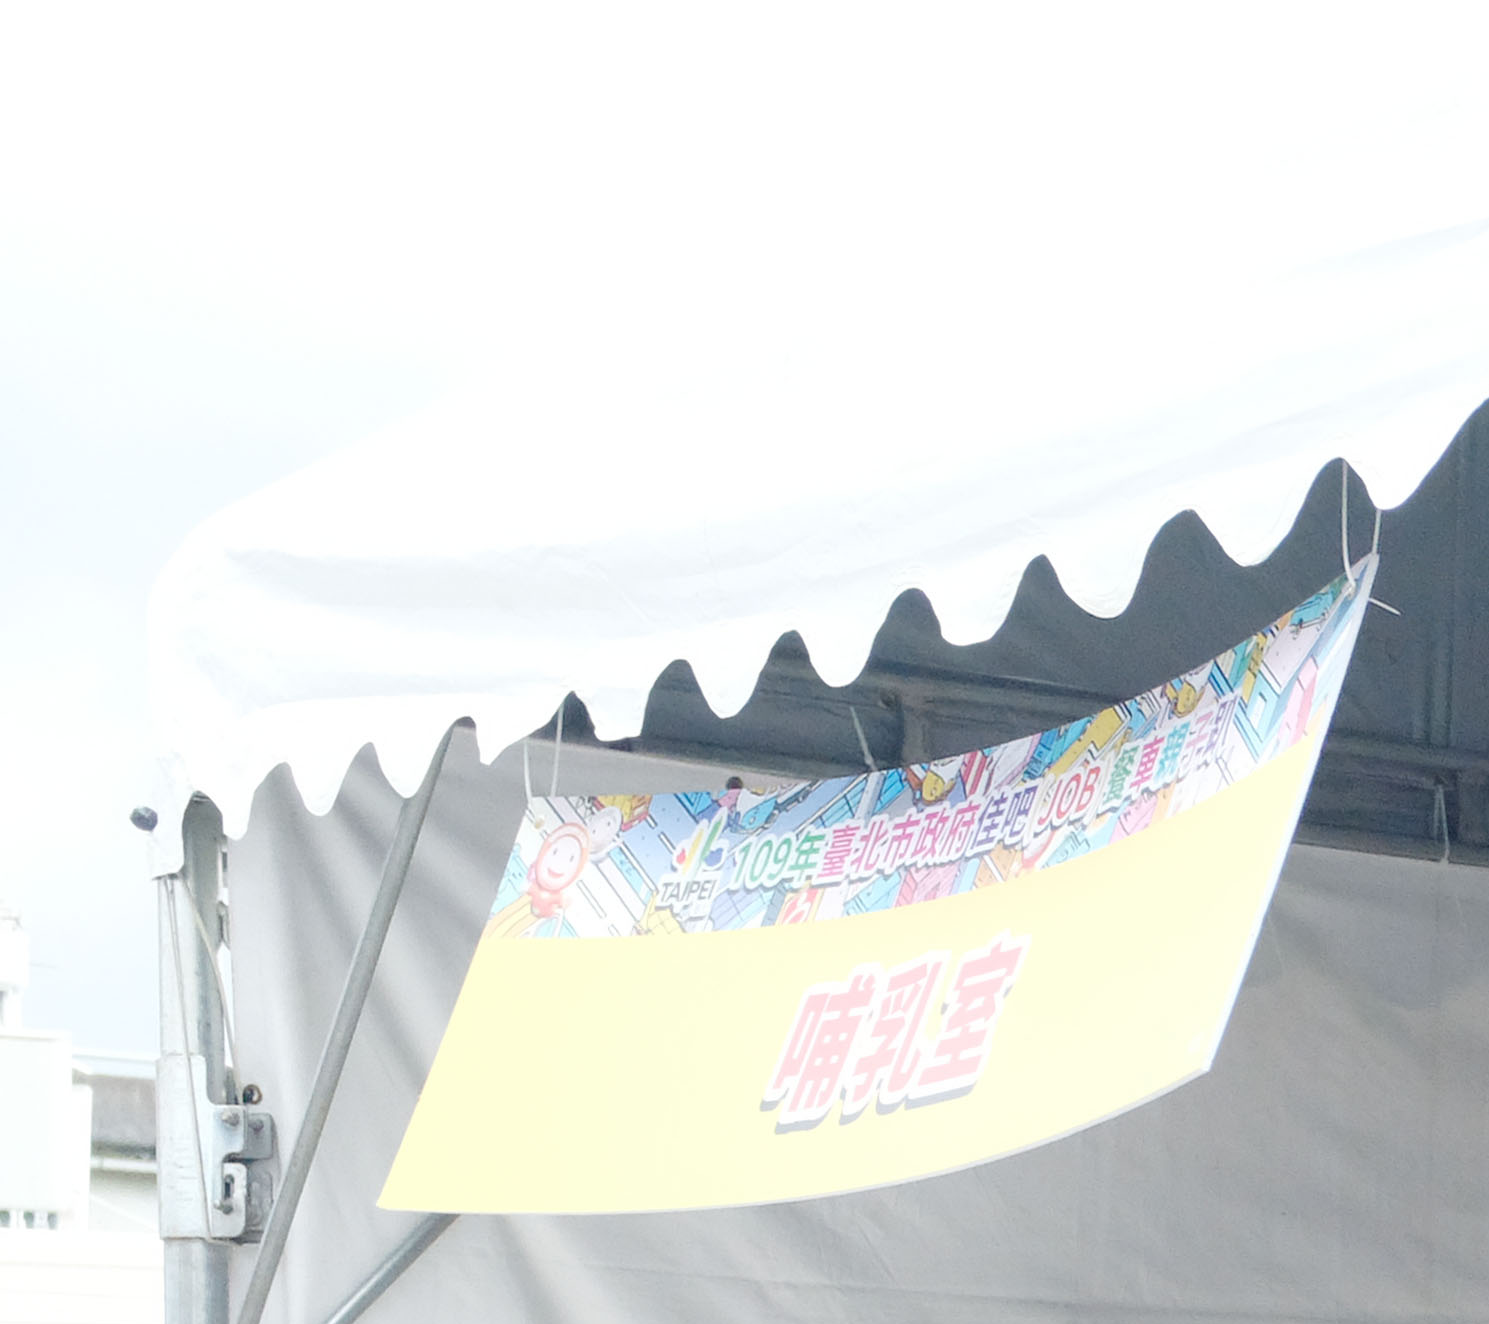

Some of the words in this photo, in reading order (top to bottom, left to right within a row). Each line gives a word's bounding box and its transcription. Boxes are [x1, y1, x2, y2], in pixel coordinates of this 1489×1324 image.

[659, 876, 718, 905] TAIPEI
[770, 940, 1025, 1114] 哺乳室
